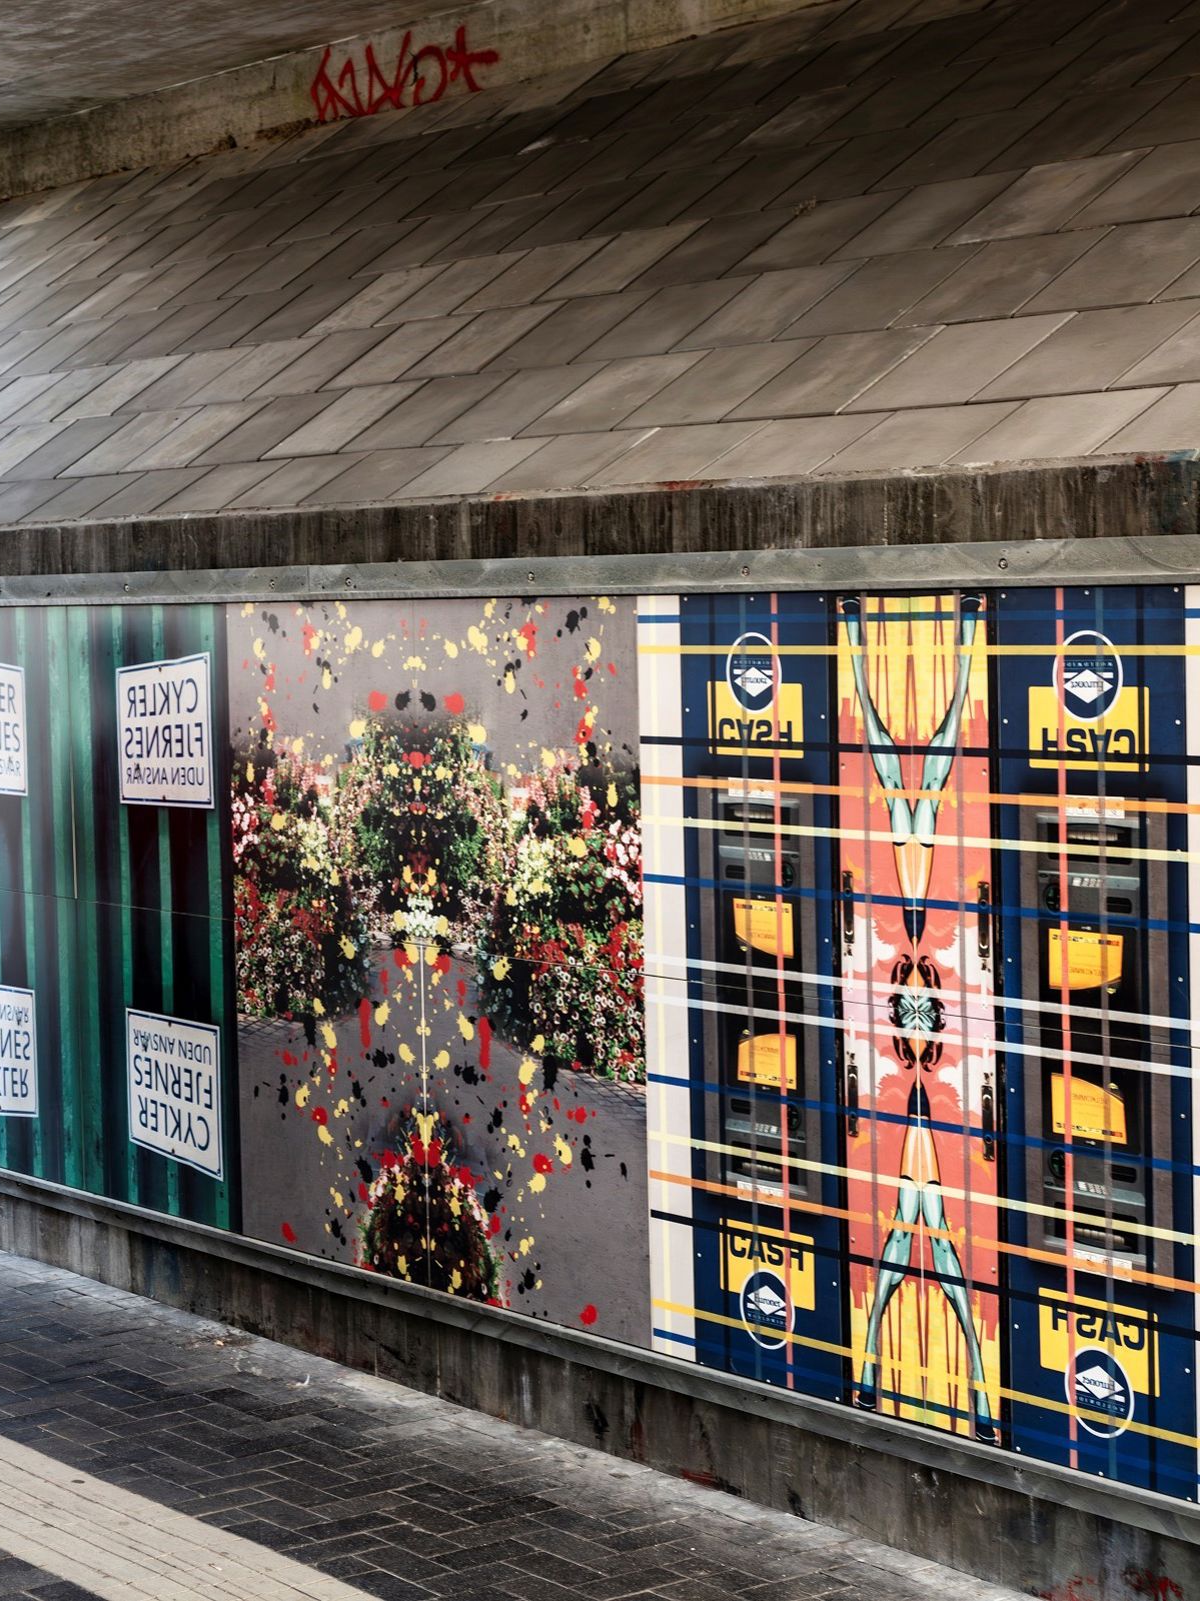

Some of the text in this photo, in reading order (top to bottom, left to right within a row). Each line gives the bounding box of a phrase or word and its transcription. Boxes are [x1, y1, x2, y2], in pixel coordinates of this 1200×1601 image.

[1042, 727, 1136, 761] CASH
[178, 1039, 212, 1065] UDEN
[134, 1054, 213, 1110] FJERNES
[138, 1094, 210, 1152] CYKLER
[730, 1233, 804, 1271] CASH
